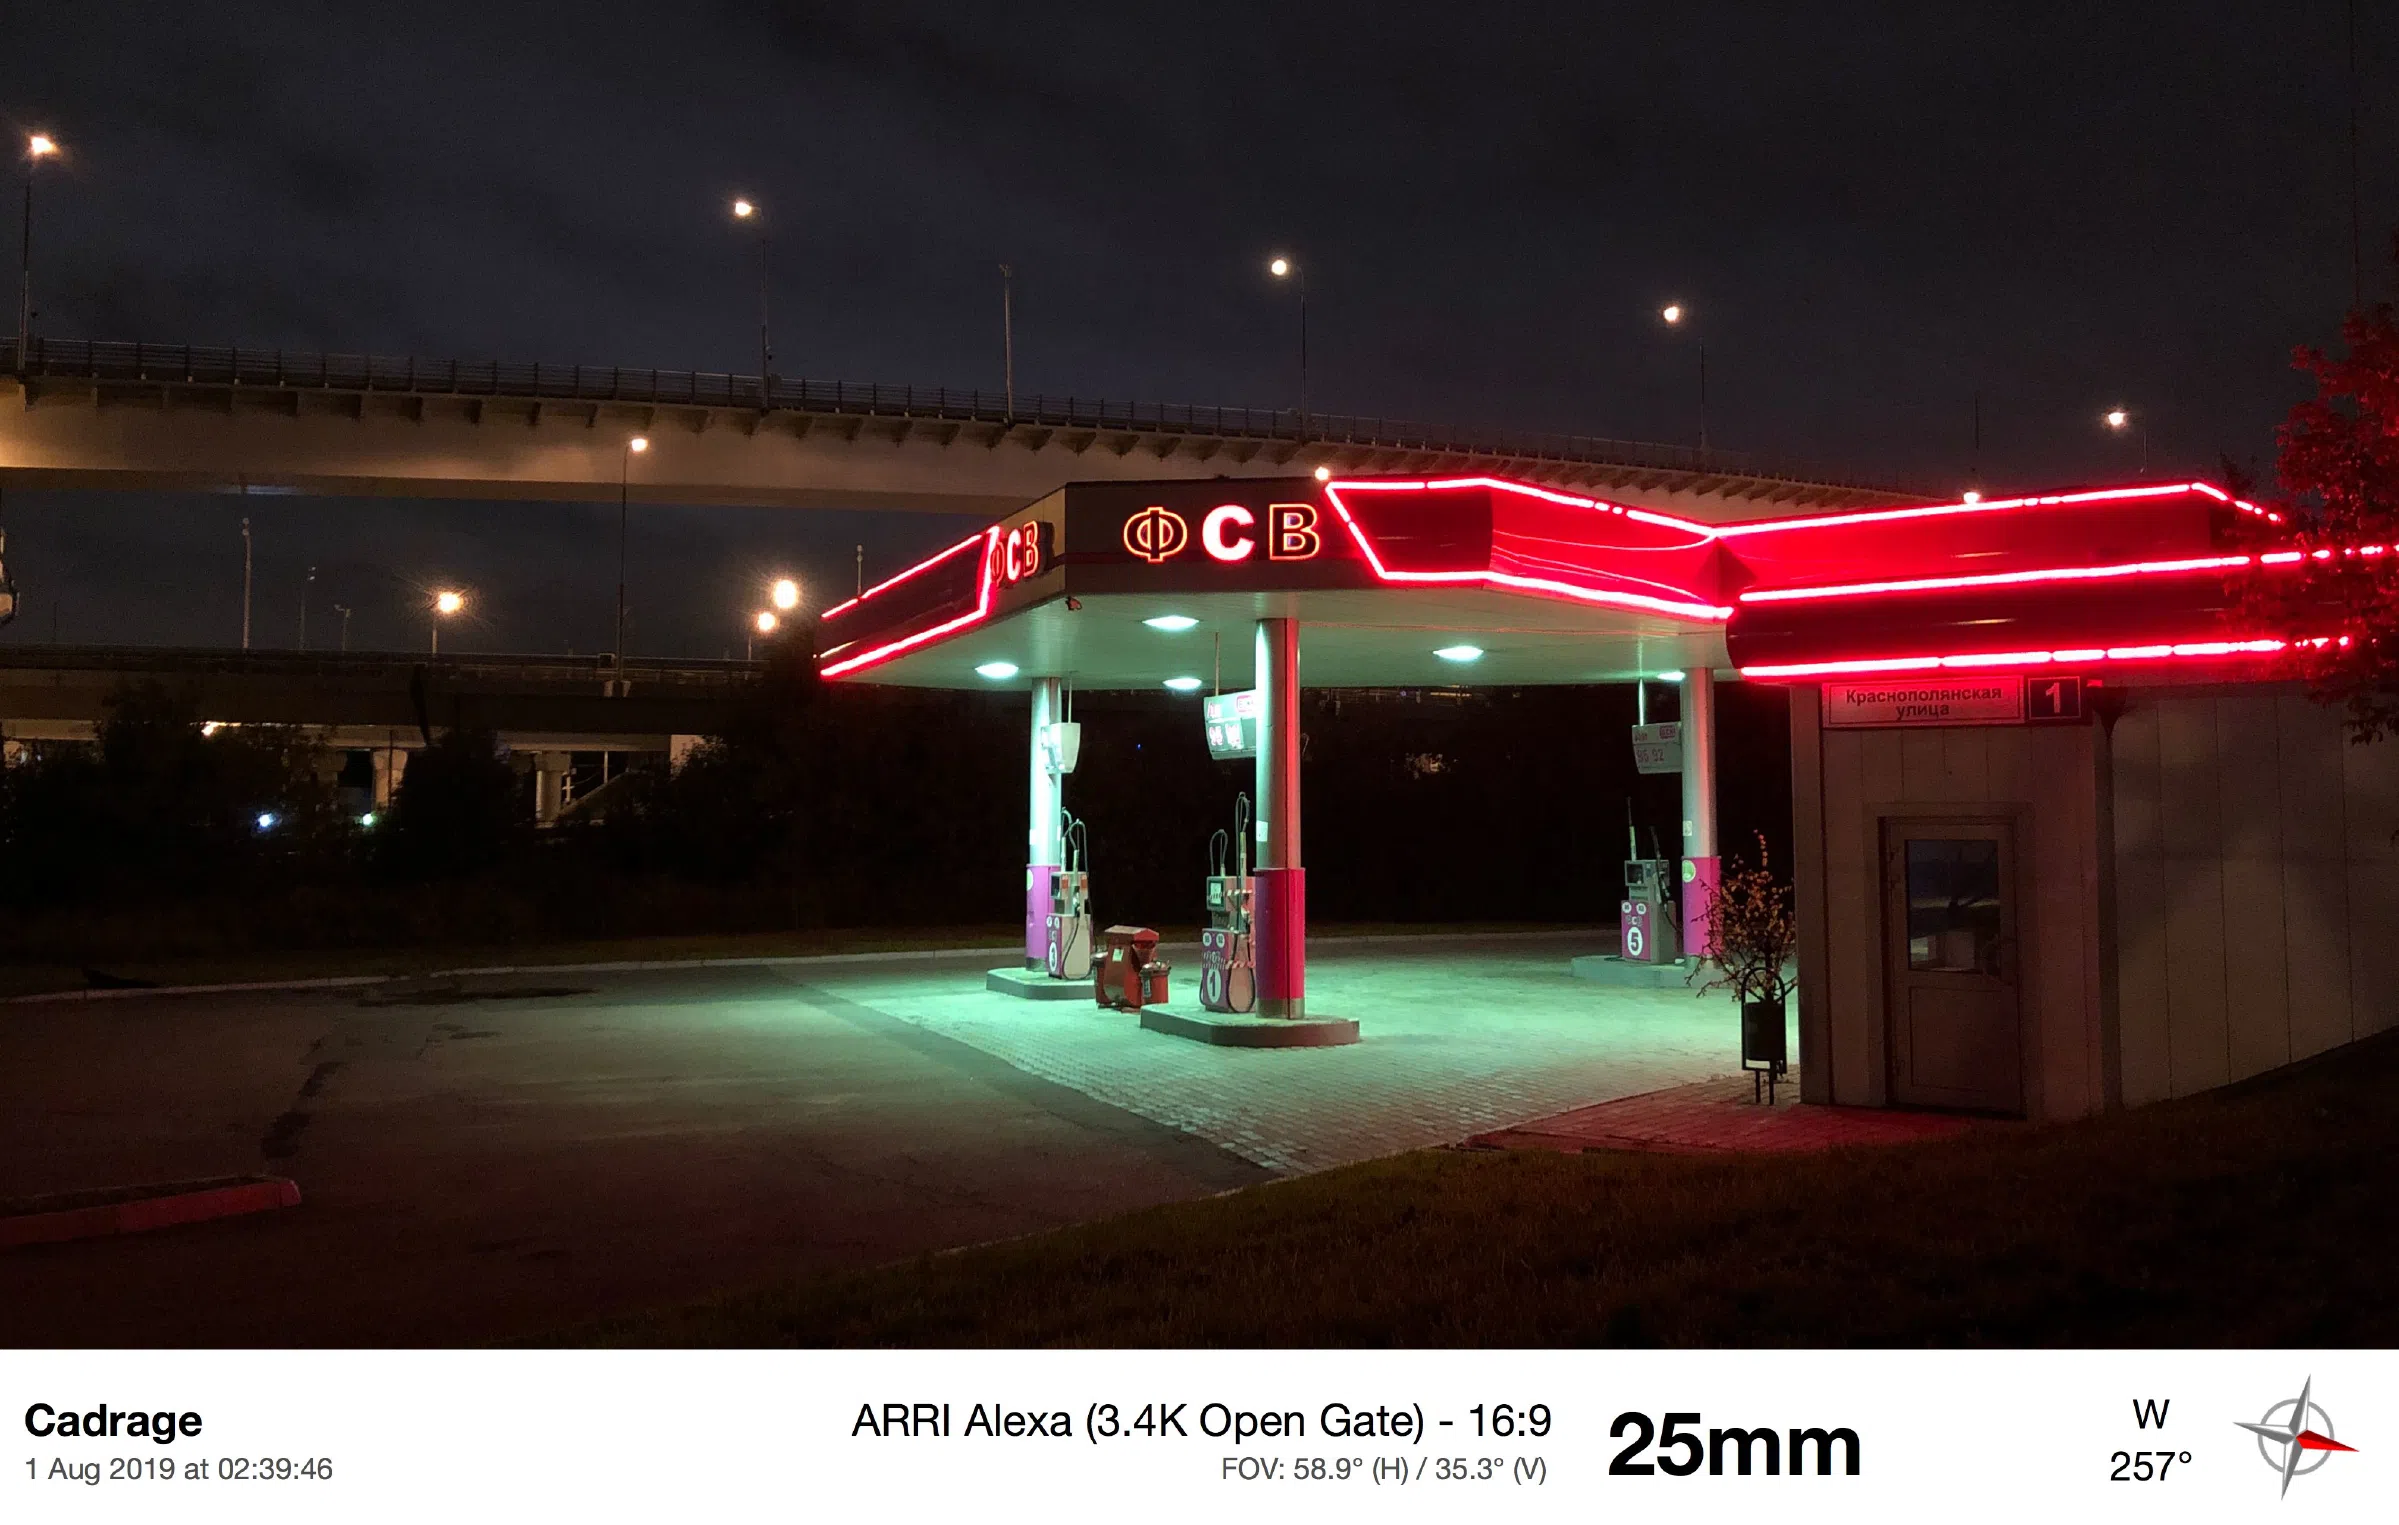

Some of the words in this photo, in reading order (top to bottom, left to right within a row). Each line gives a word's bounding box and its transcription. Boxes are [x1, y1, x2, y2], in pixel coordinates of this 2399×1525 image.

[1122, 503, 1320, 563] ФСВ
[1845, 685, 2003, 707] Краснополянская
[2045, 681, 2062, 714] 1
[1895, 703, 1951, 721] улица
[1629, 931, 1640, 952] 5
[1209, 970, 1216, 998] 1
